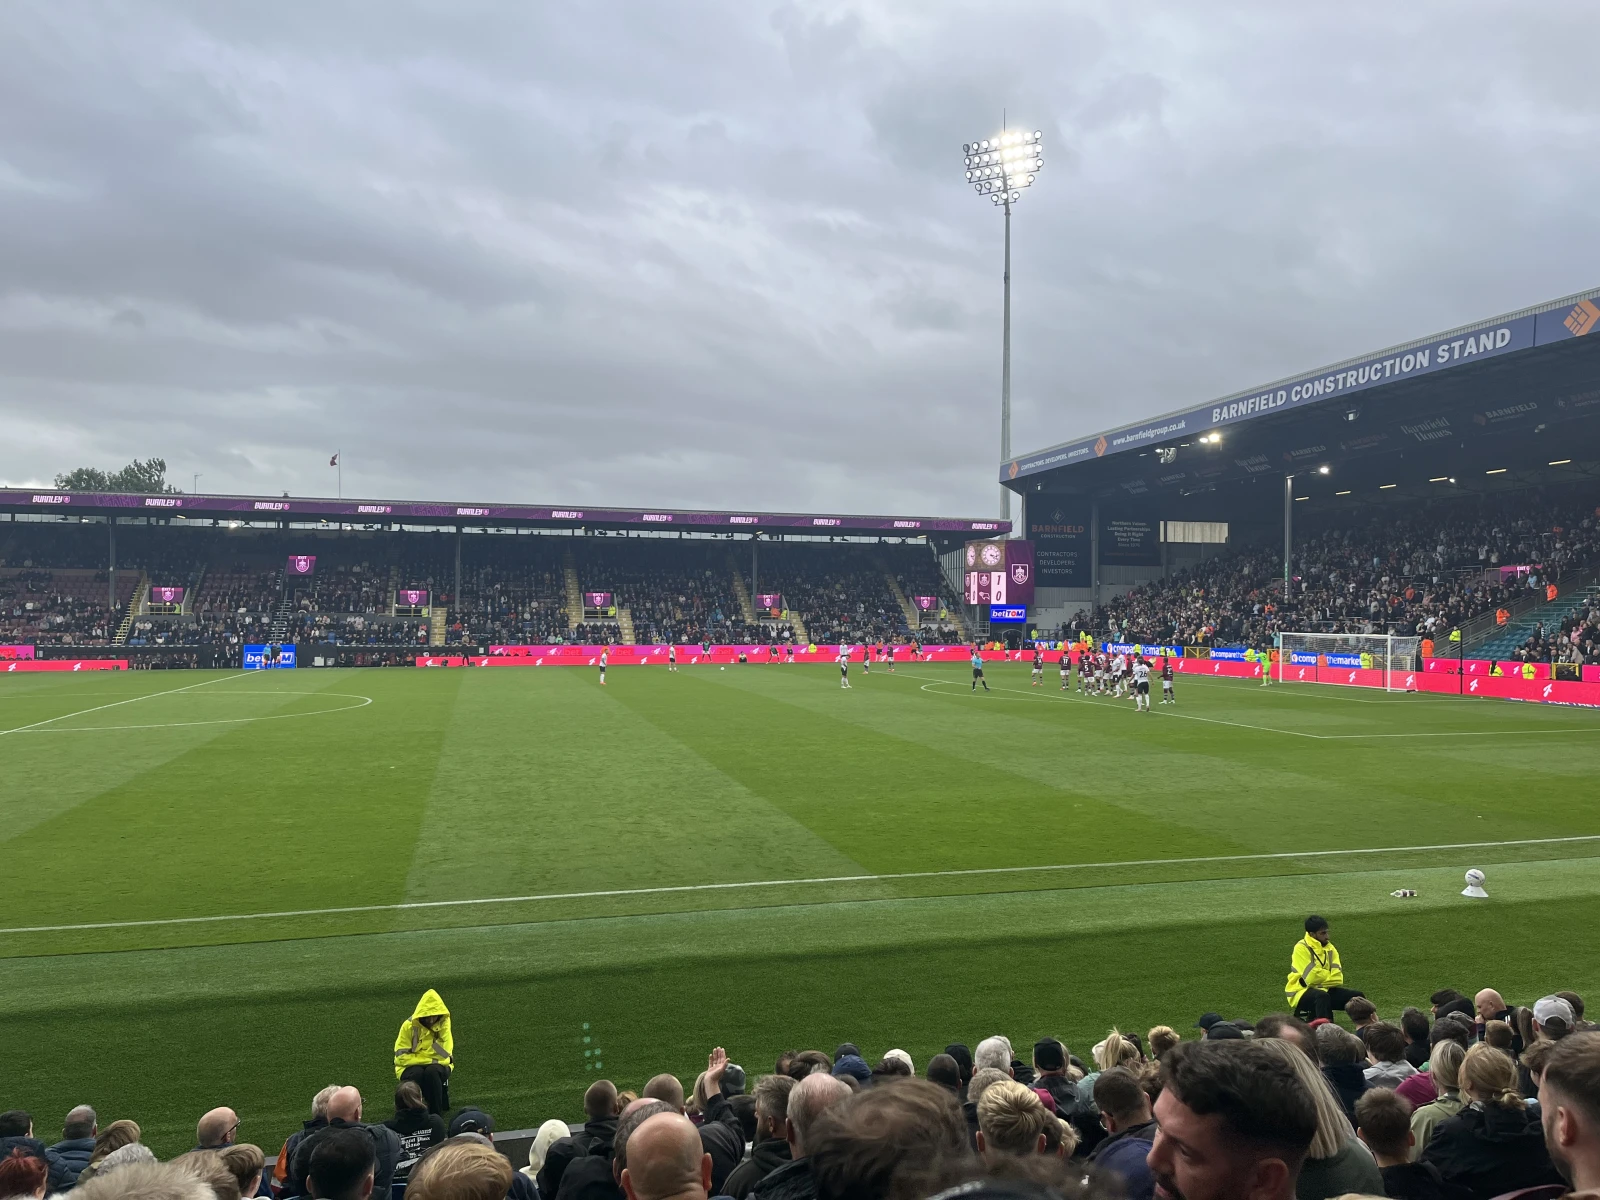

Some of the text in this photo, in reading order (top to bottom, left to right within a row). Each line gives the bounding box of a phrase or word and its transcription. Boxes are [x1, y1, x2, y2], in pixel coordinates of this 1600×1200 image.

[1212, 328, 1512, 423] BARNFIELD CONSTRUCTION STAND
[1485, 402, 1538, 419] BARNFIELD
[1112, 420, 1186, 446] www.barnfieldgroup.co.uk
[32, 495, 63, 503] BURNLEY
[145, 498, 175, 507] BURNLEY
[254, 501, 283, 510] BURNLEY
[1031, 524, 1084, 534] BARNFIELD
[997, 575, 1001, 586] 1
[996, 591, 1002, 602] 0
[1084, 664, 1089, 672] 5
[1139, 670, 1147, 678] 26
